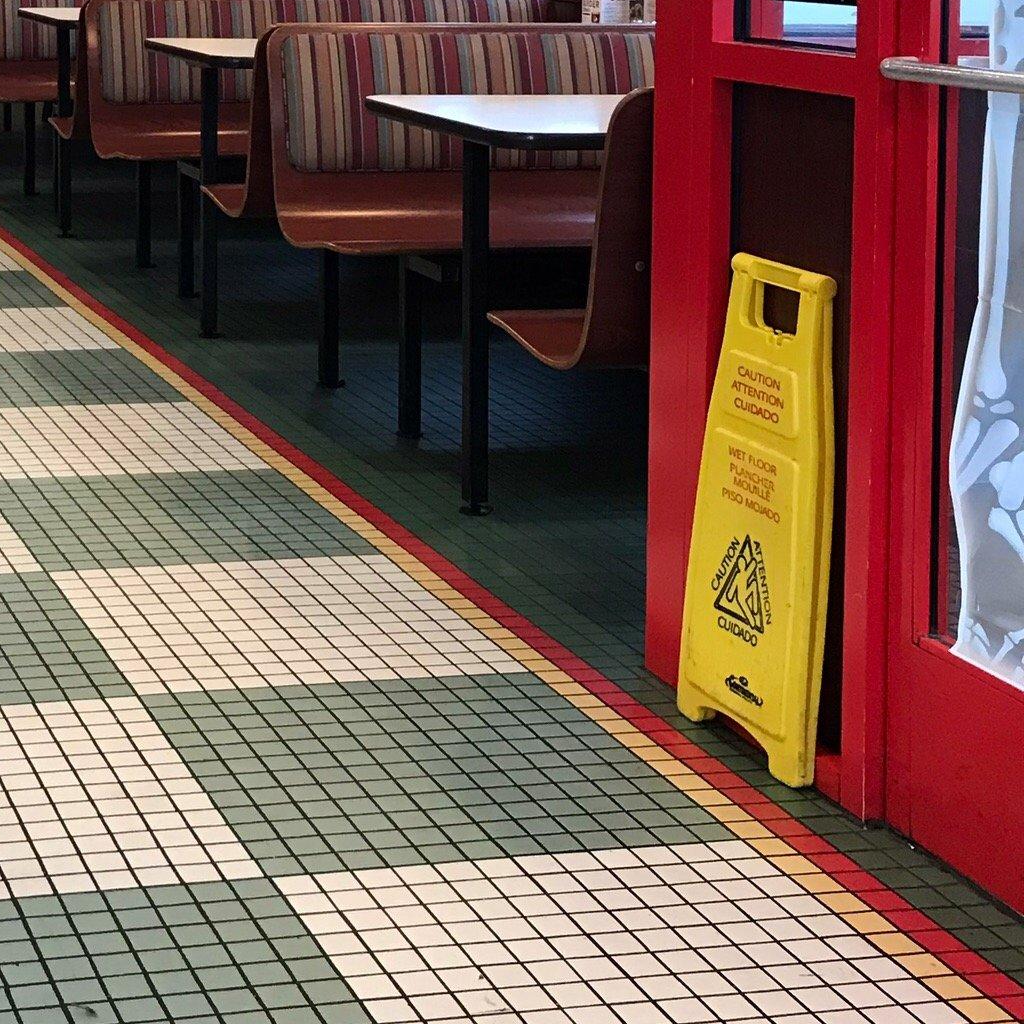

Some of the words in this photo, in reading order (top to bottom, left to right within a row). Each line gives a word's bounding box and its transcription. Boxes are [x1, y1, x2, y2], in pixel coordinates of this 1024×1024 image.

[738, 366, 780, 391] CAUTION
[731, 380, 784, 410] ATTENTION
[734, 397, 780, 424] CUIDADO
[728, 445, 746, 462] WET
[748, 454, 777, 476] FLOOR
[730, 462, 775, 491] PLANCHER
[733, 476, 772, 502] MOUILLÉ
[722, 487, 744, 505] PISO
[745, 498, 781, 524] MOJADO
[711, 536, 741, 591] CAUTION
[753, 540, 772, 626] ATTENTION
[717, 615, 758, 647] CUIDADO
